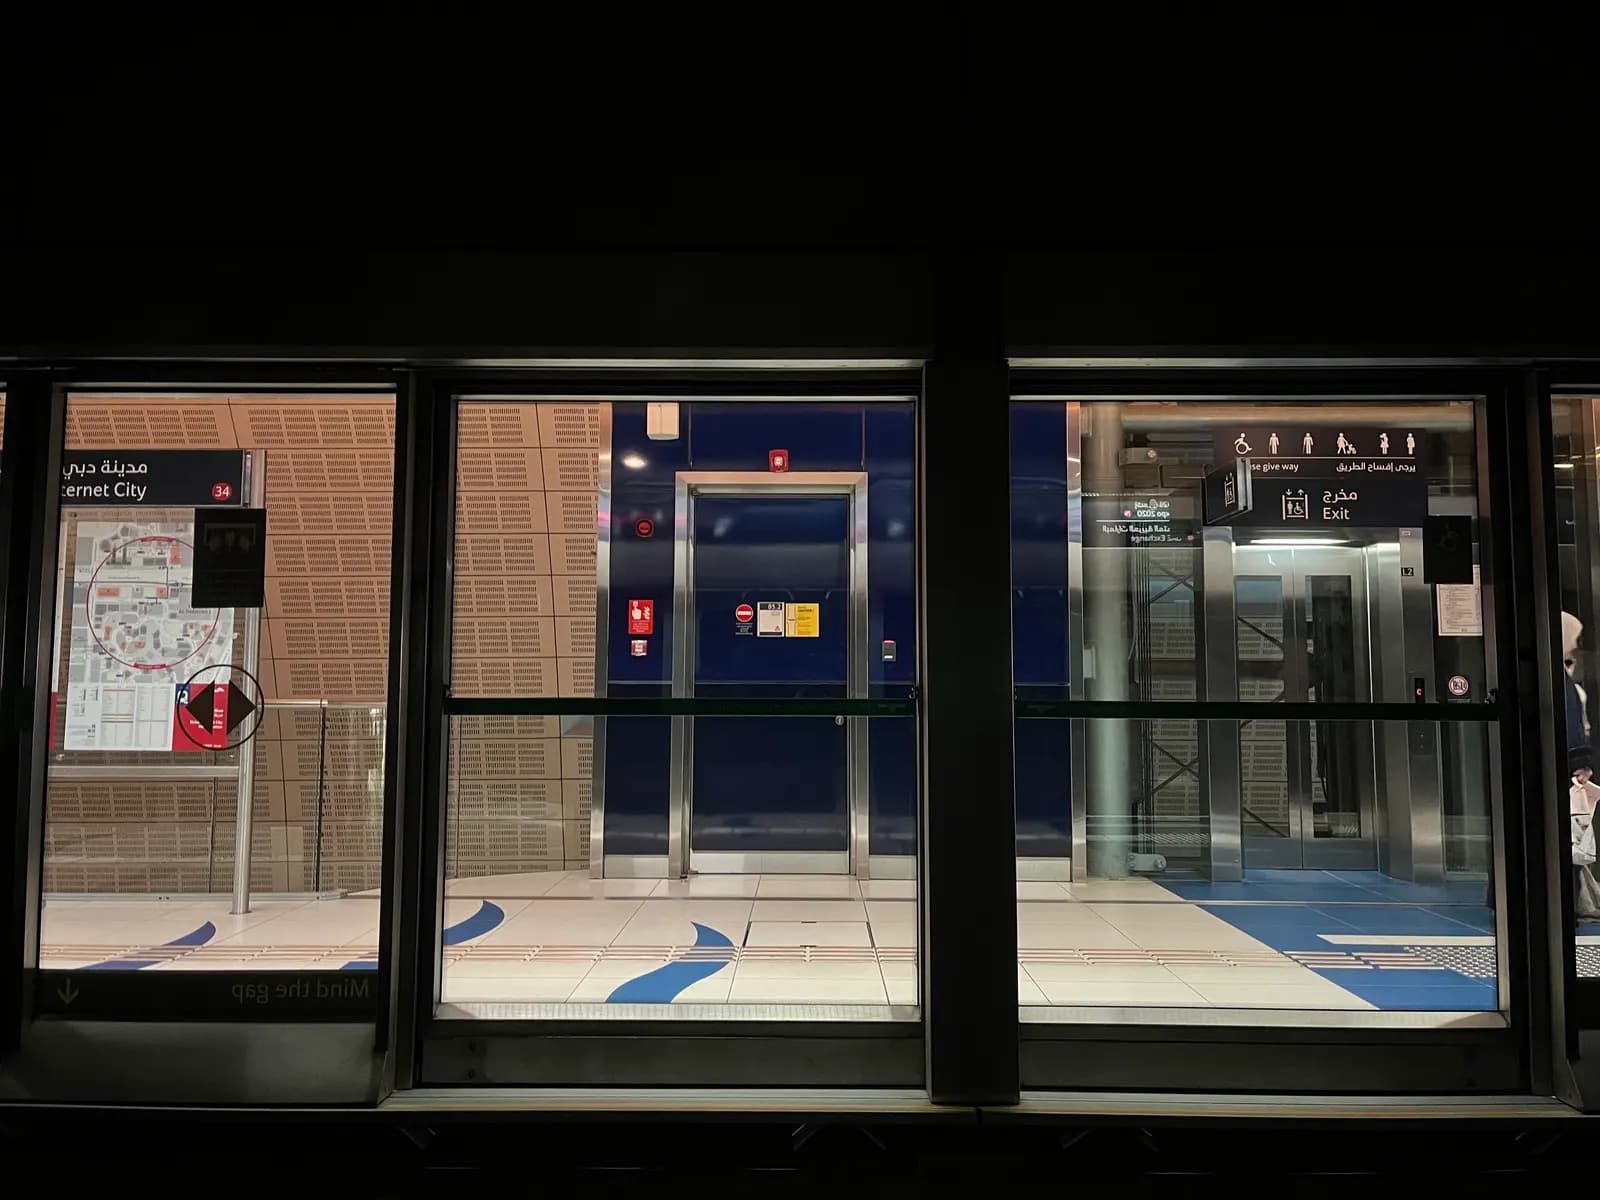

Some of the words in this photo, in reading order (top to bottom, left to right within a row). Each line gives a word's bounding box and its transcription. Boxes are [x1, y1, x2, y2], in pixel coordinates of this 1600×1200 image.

[62, 463, 96, 480] دبي
[100, 460, 148, 477] مدينة
[1263, 462, 1280, 473] give
[1282, 463, 1299, 473] way
[114, 481, 147, 501] City
[215, 486, 229, 497] 34
[1323, 489, 1357, 503] مخرج
[1323, 507, 1350, 520] Exit
[1402, 568, 1414, 576] L2
